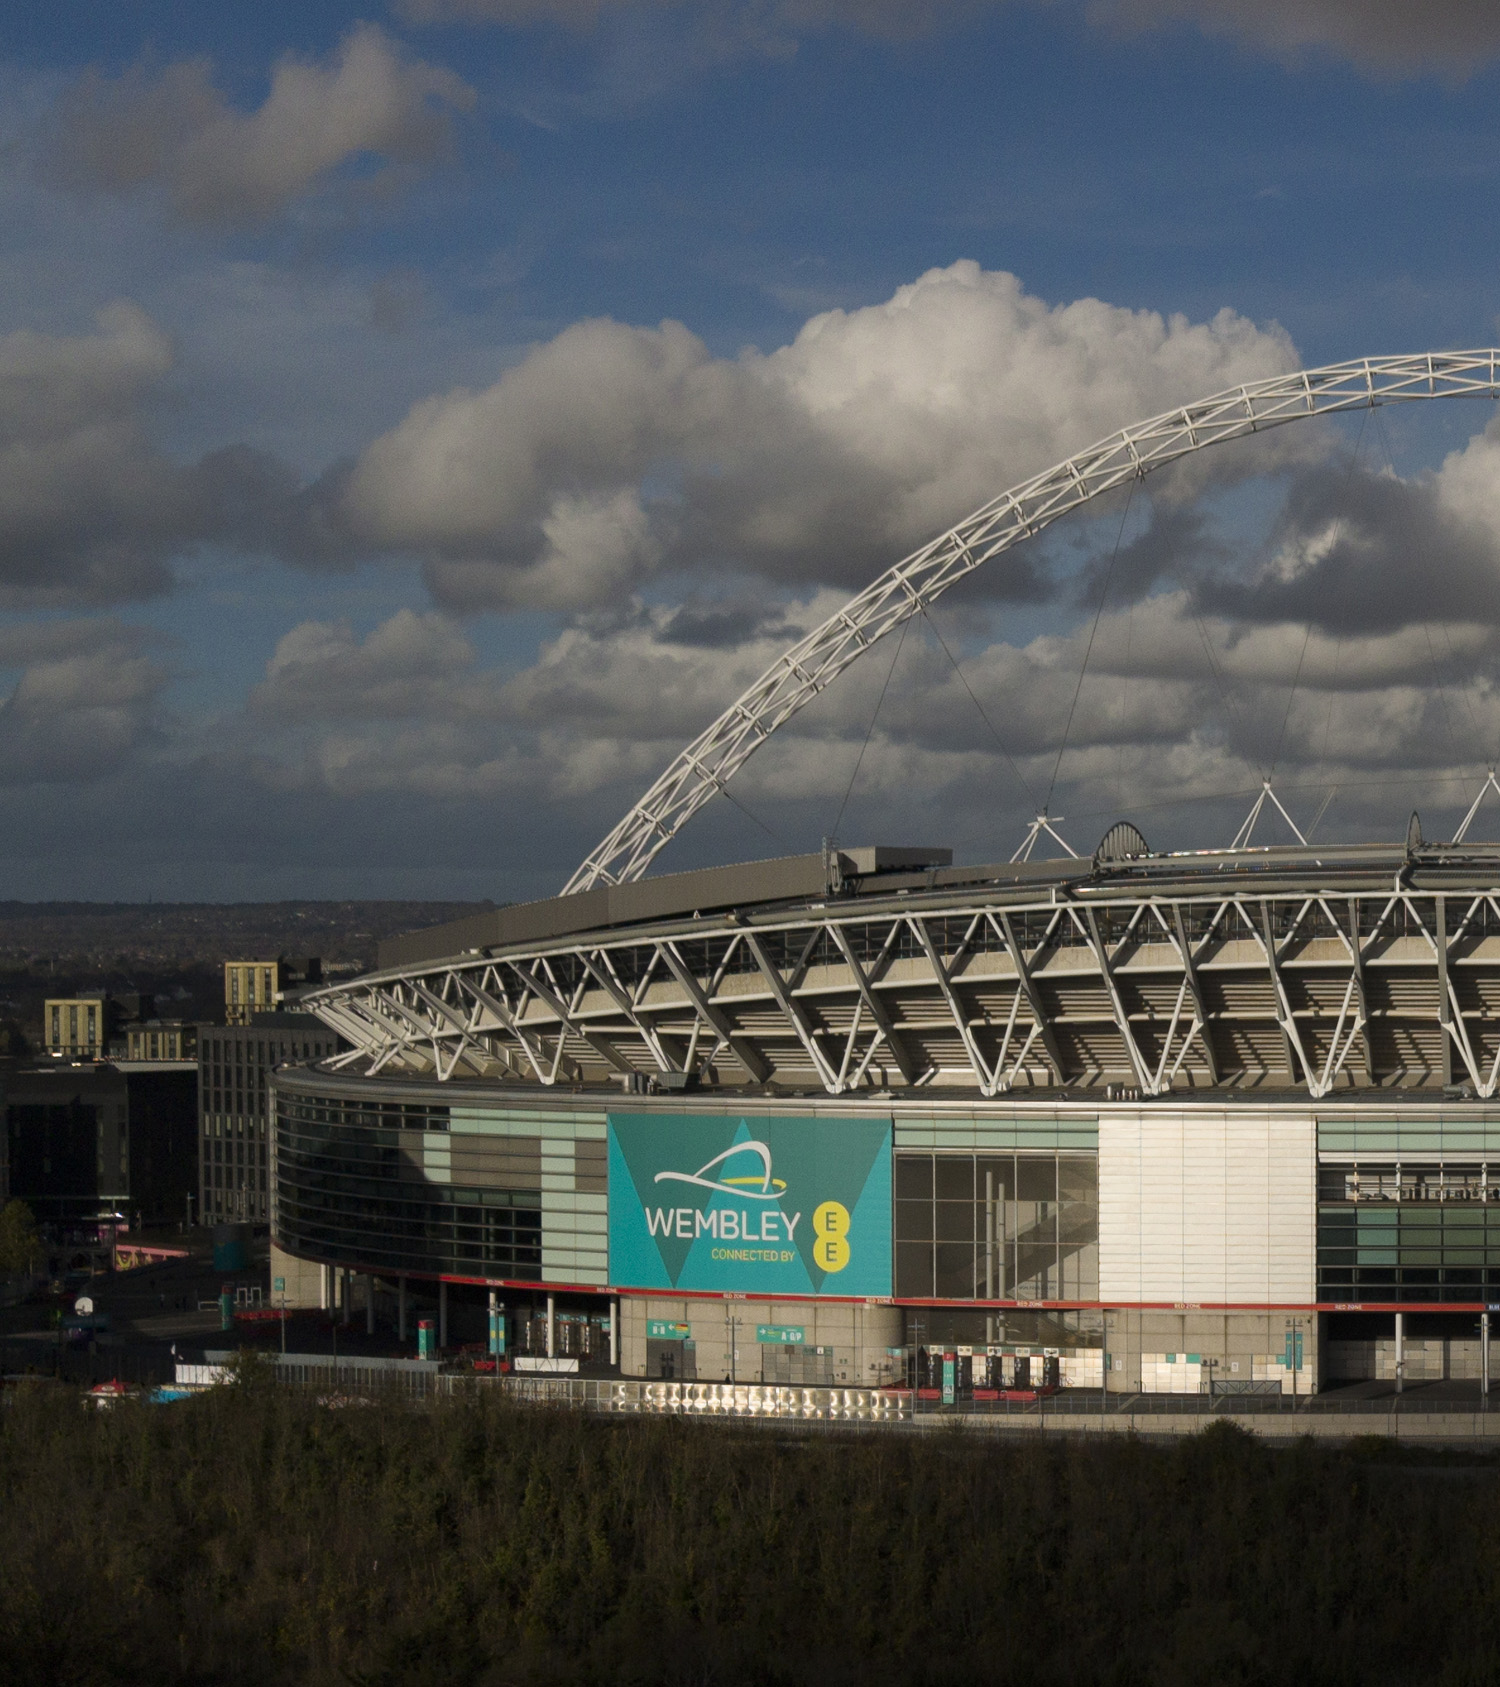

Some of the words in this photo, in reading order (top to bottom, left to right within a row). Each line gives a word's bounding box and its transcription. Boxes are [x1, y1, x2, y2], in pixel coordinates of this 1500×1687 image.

[645, 1207, 801, 1241] WEMBLEY
[711, 1248, 778, 1262] CONNECTED
[780, 1250, 795, 1262] BY
